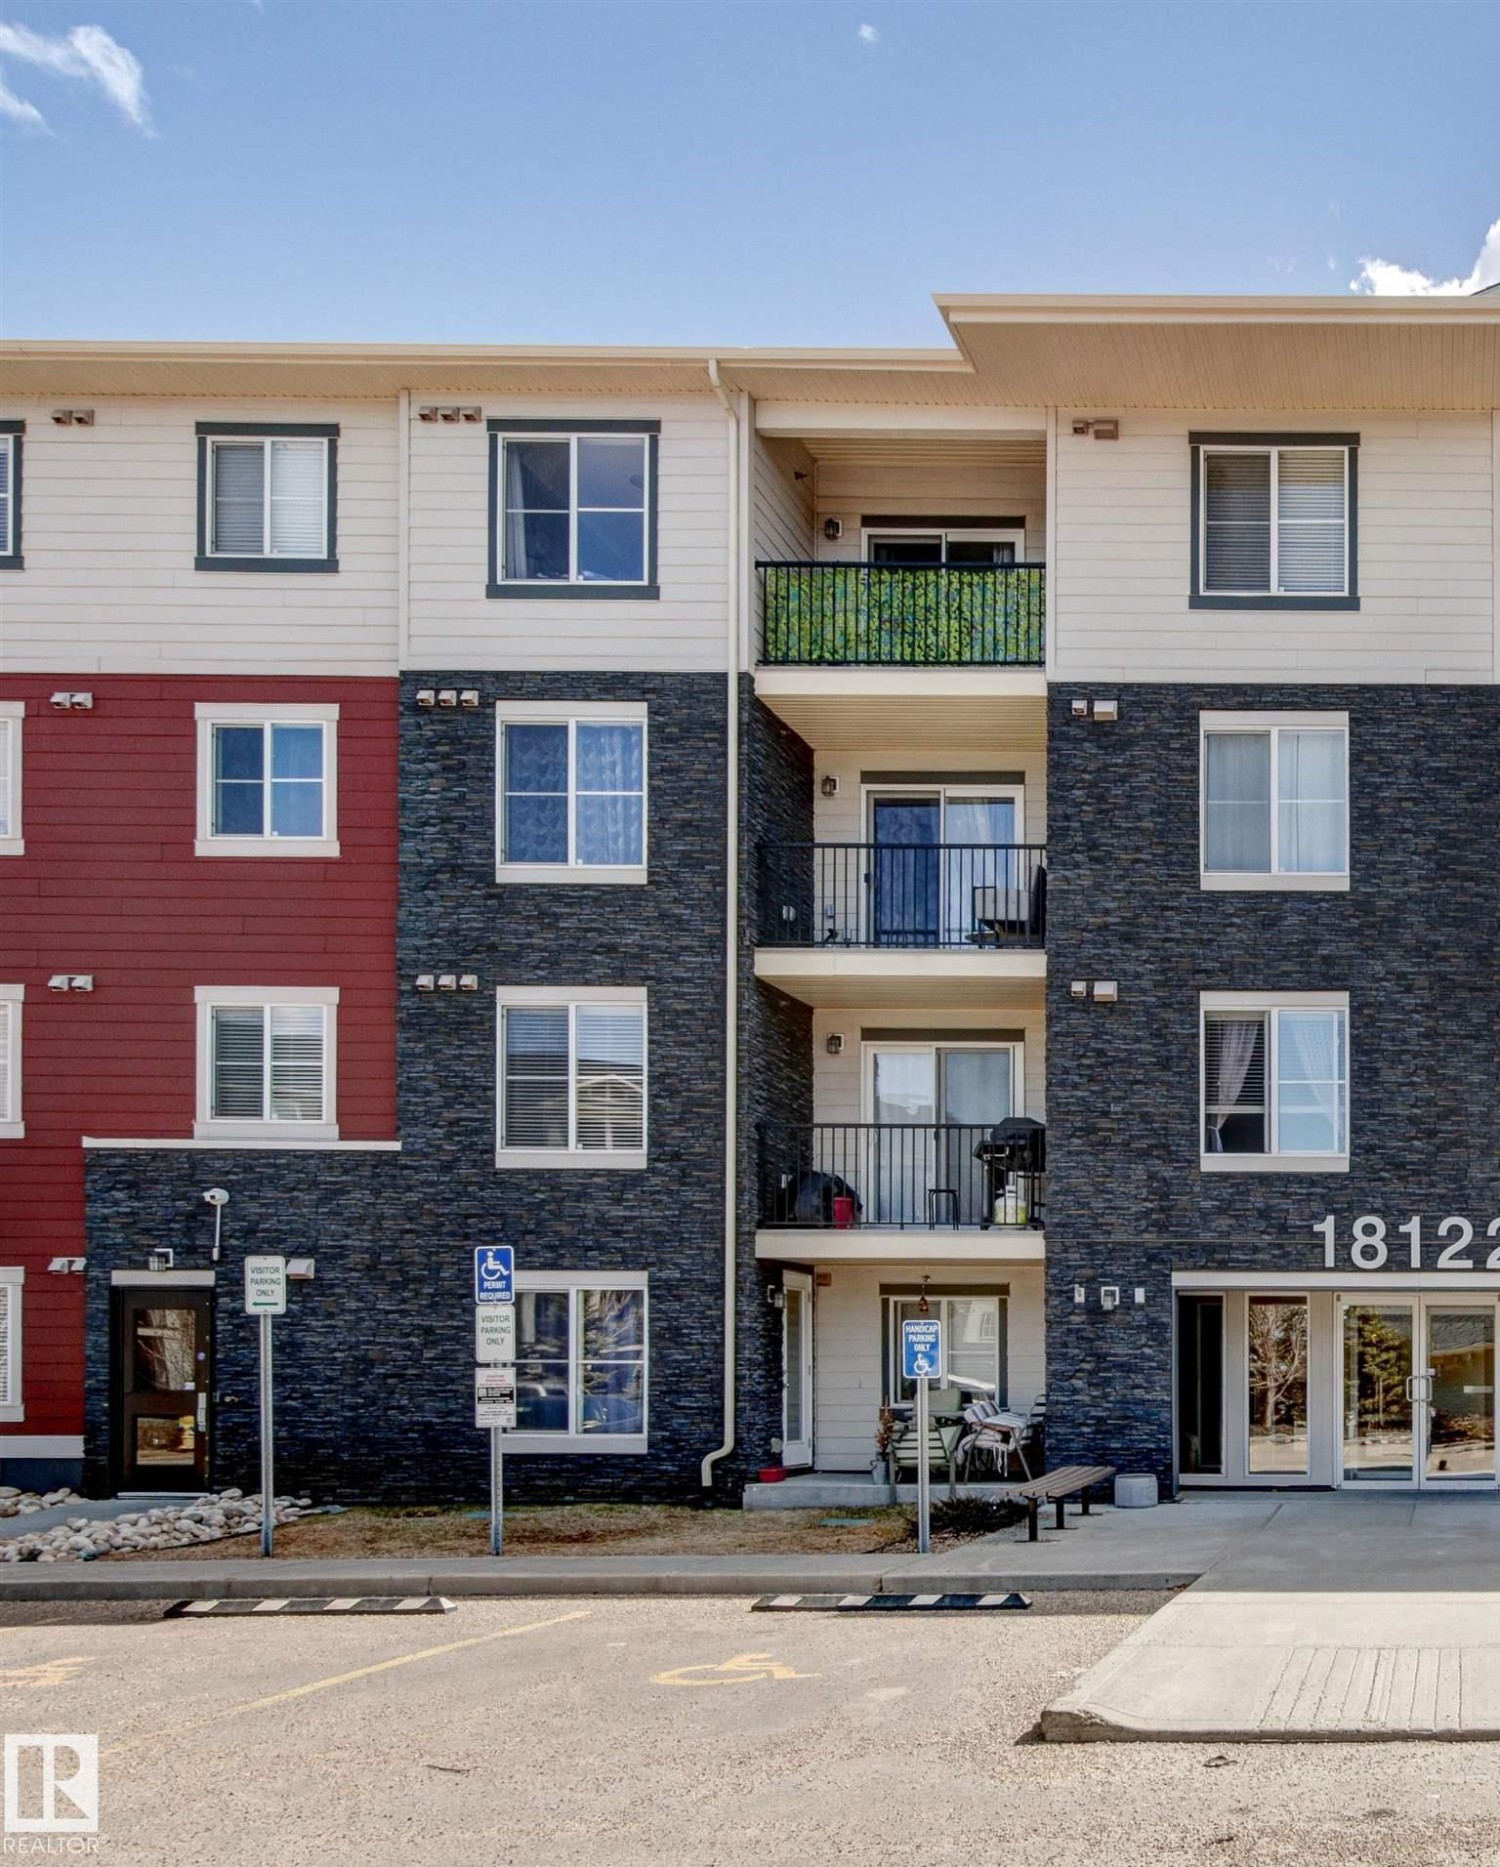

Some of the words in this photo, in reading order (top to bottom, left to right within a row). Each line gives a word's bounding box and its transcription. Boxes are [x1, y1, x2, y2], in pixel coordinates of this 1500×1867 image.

[250, 1266, 281, 1274] VISITOR
[250, 1277, 281, 1286] PARKING
[483, 1281, 506, 1289] PERMIT
[256, 1289, 275, 1297] ONLY
[479, 1292, 511, 1300] REQUIRED
[481, 1315, 510, 1323] VISITOR
[480, 1326, 511, 1335] PARKING
[905, 1325, 938, 1333] HANDICAP
[486, 1337, 505, 1346] ONLY
[908, 1334, 936, 1342] PARKING
[914, 1343, 931, 1352] ONLY
